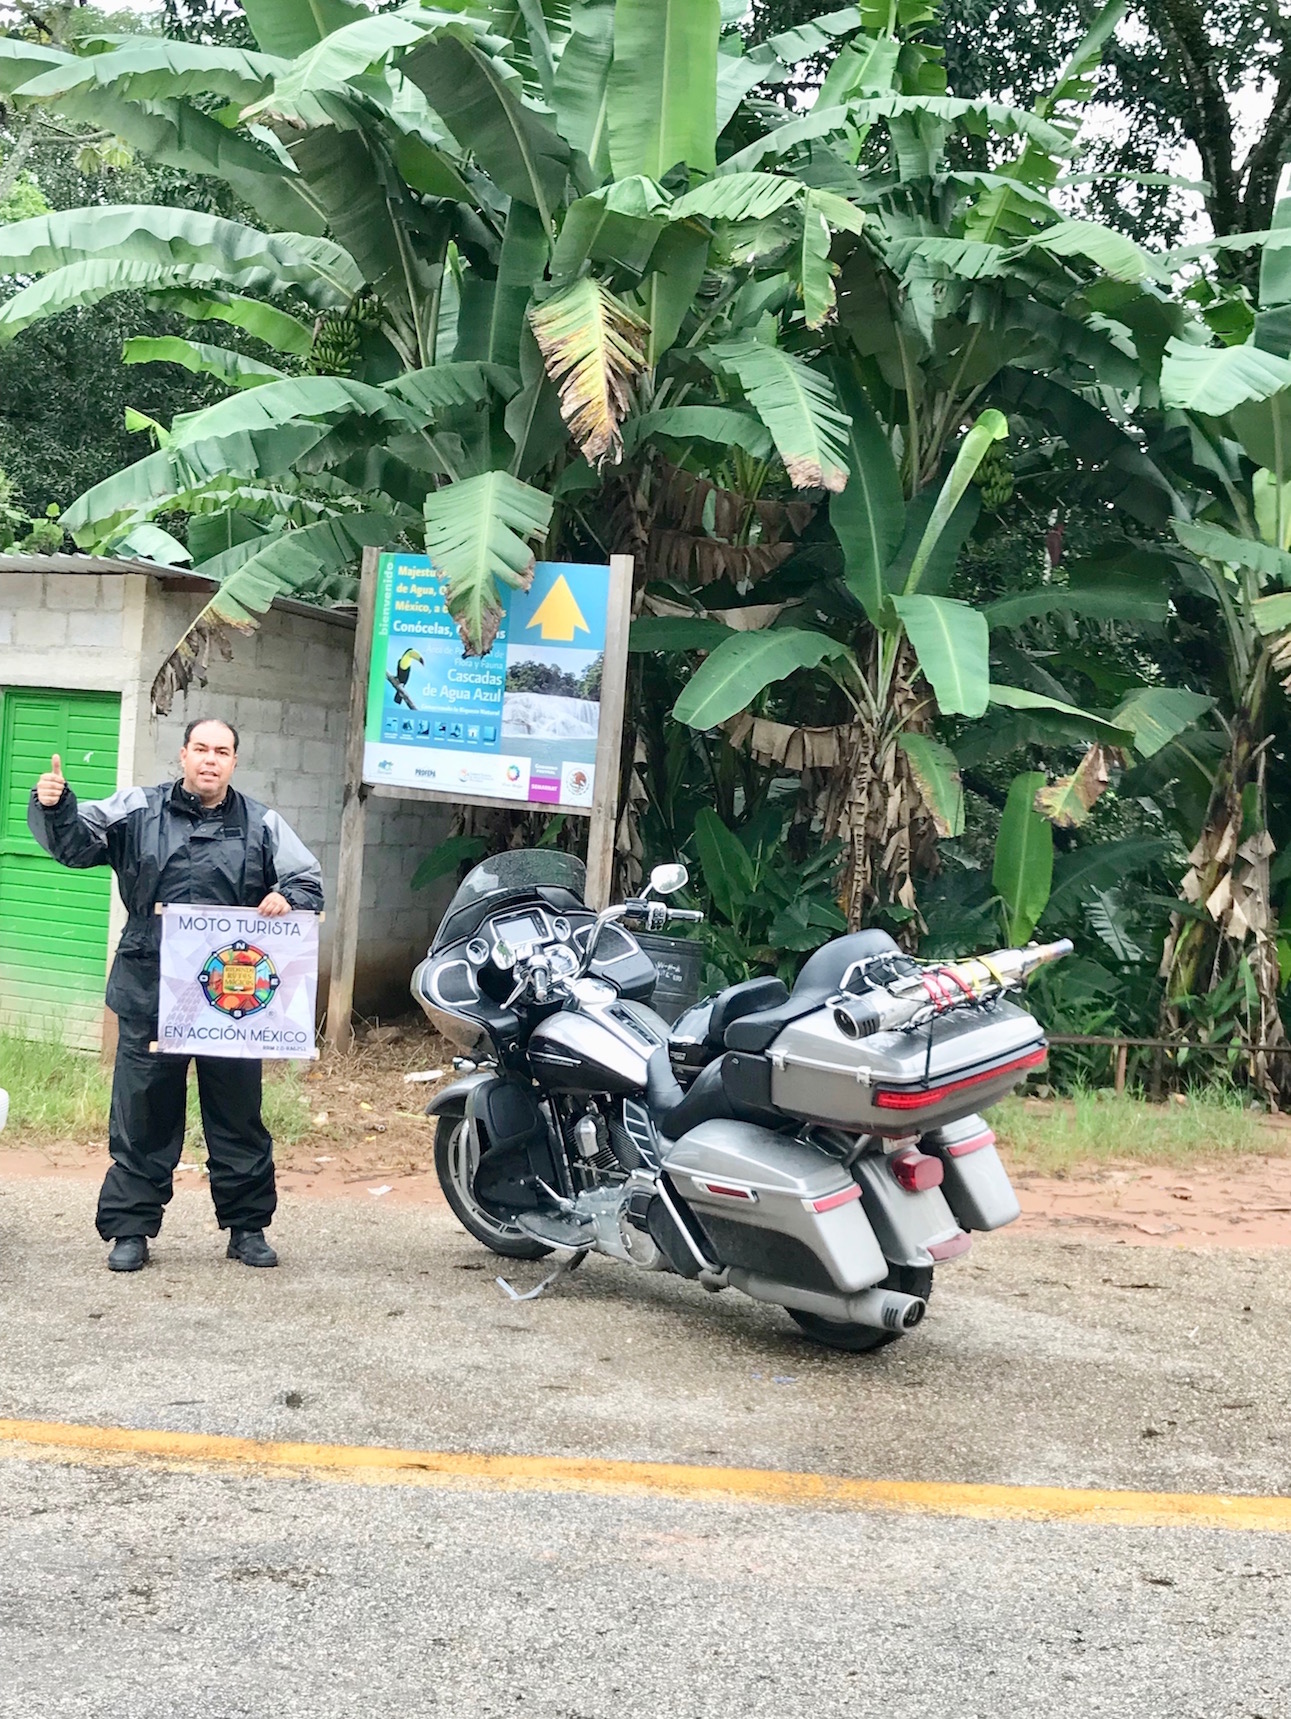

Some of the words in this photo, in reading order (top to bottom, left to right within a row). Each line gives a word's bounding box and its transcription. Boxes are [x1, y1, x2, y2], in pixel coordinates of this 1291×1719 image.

[398, 566, 444, 579] Majestu
[379, 562, 394, 636] bienvenido
[396, 584, 408, 594] de
[410, 585, 436, 598] Agua,
[395, 600, 432, 614] México,
[434, 605, 441, 614] a
[393, 620, 453, 637] Conócelas,
[454, 658, 473, 667] Flora
[474, 661, 479, 670] y
[481, 660, 503, 669] Fauna
[447, 669, 503, 686] Cascadas
[422, 683, 437, 697] de
[440, 685, 471, 703] Agua
[473, 688, 501, 703] Azul
[179, 916, 231, 932] MOTO
[236, 919, 301, 936] TURISTA
[164, 1025, 184, 1038] EN
[187, 1024, 247, 1041] ACCIÓN
[250, 1027, 307, 1043] MÉXICO
